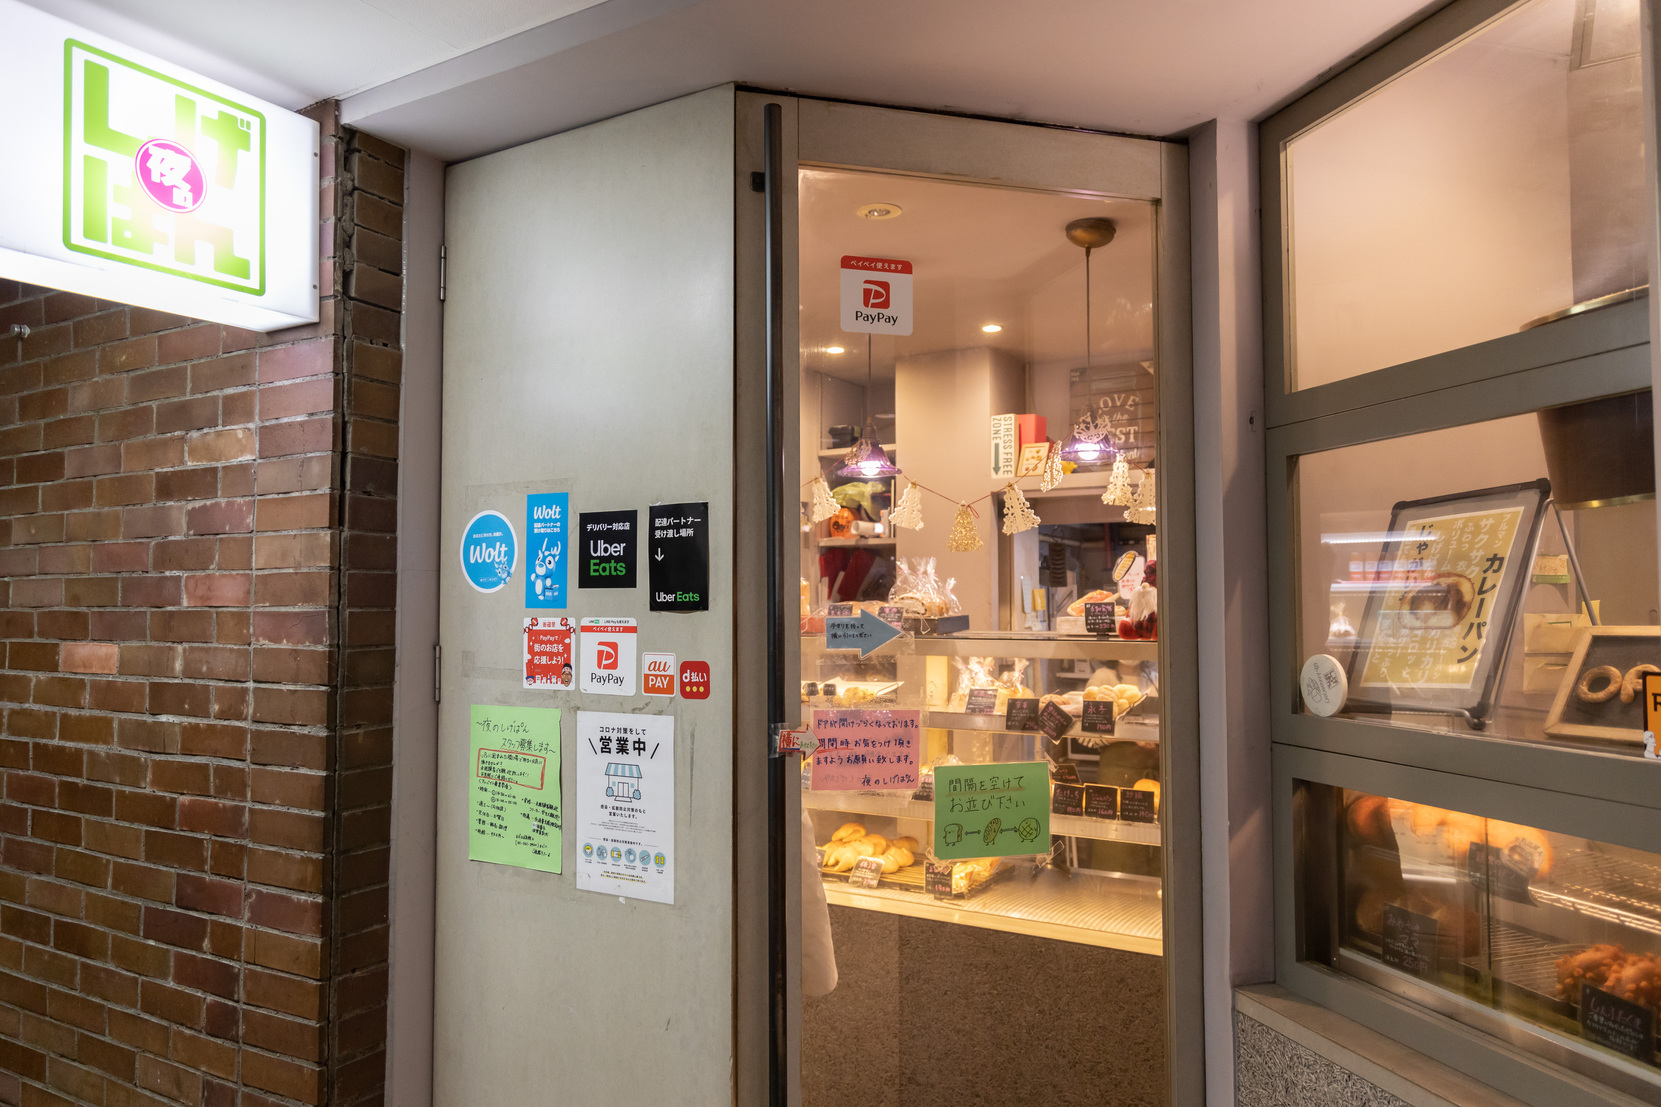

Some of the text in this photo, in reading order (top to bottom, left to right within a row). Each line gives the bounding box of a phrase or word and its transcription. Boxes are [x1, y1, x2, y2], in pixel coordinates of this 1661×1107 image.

[850, 260, 903, 271] ペイペイ使えます
[855, 310, 898, 326] PayPay
[992, 417, 1002, 440] ZONE
[1003, 416, 1012, 475] STRESS FREE
[533, 504, 561, 520] Wolt
[586, 522, 630, 531] デリバリー対応店
[654, 516, 702, 527] 配達パートナー
[654, 528, 694, 539] 受け渡し場所
[590, 540, 626, 557] Uber
[1441, 518, 1466, 571] ボリューム
[1465, 517, 1495, 579] サクサク
[470, 542, 508, 564] Wolt
[590, 559, 626, 576] Eats
[655, 591, 700, 602] Uber Eats
[1457, 553, 1505, 664] カレーパン
[533, 643, 564, 653] 街のお店を
[533, 655, 564, 664] 応援しよう!
[648, 660, 671, 672] au
[590, 672, 624, 687] PayPay
[649, 676, 669, 688] PAY
[682, 669, 707, 682] d払い
[599, 726, 646, 736] コロナ対策をして
[817, 717, 919, 730] ドアが開けづらくなっております。
[599, 735, 646, 757] 営業中
[782, 731, 800, 749] 横に
[816, 754, 914, 766] ますようお願い致します。
[861, 774, 915, 787] 夜のしげぱん
[948, 776, 1024, 793] 間隔を空けて
[949, 795, 1026, 813] お並び下さい
